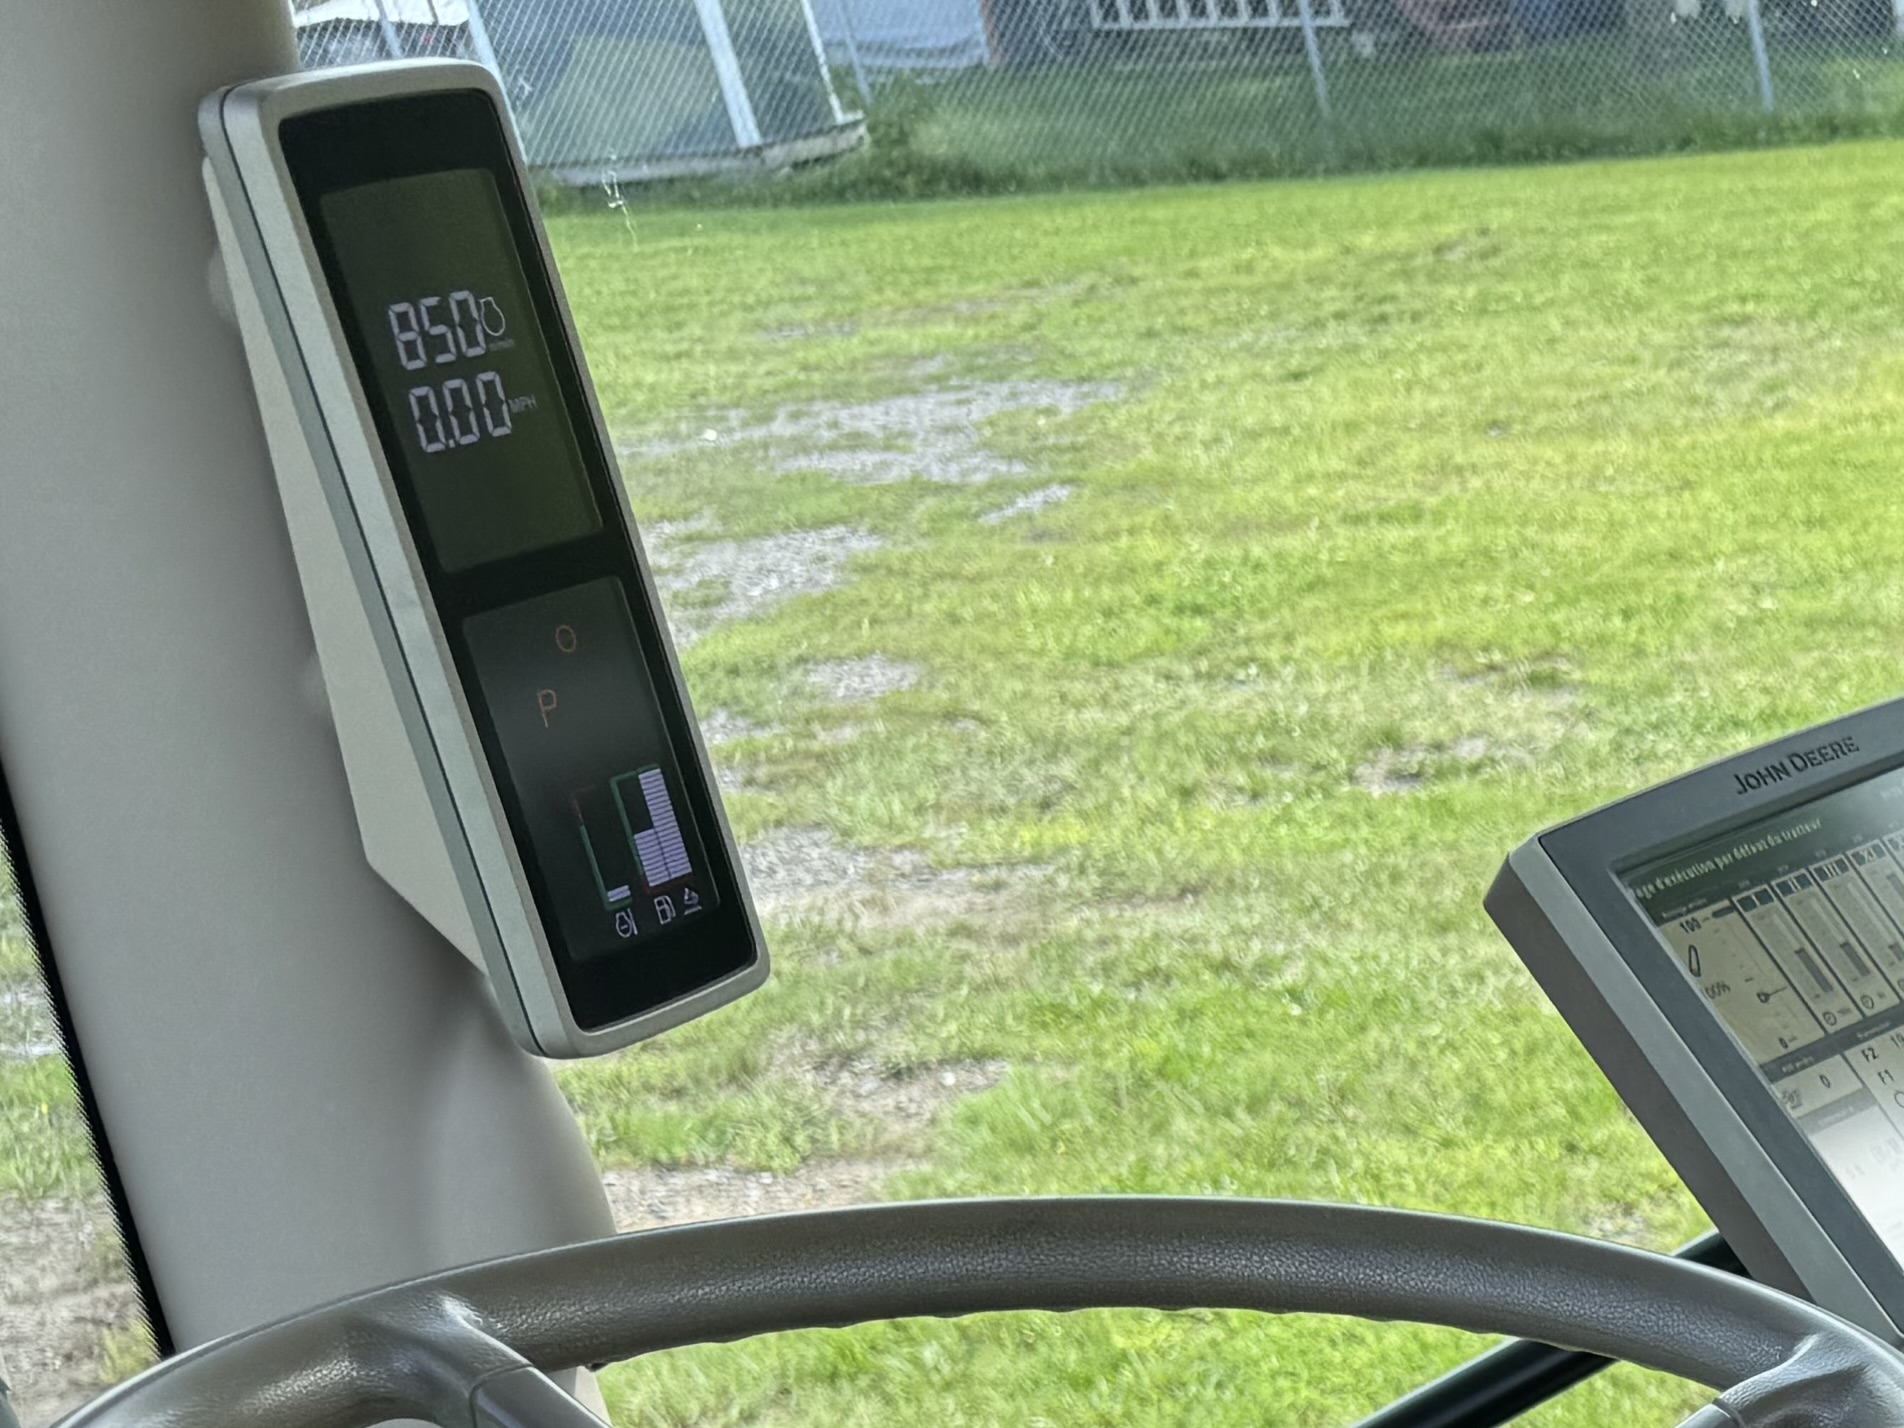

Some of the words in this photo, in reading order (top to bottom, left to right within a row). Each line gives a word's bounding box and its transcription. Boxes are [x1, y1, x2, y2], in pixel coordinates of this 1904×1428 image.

[388, 290, 486, 370] 850
[409, 371, 512, 453] 0.00
[536, 689, 557, 728] P
[1733, 761, 1789, 796] JOHN
[1790, 736, 1860, 773] DEERE
[1713, 852, 1733, 869] par
[1766, 834, 1782, 846] du
[1678, 916, 1701, 933] 100
[1860, 1046, 1879, 1062] F2
[1876, 1068, 1894, 1085] F1
